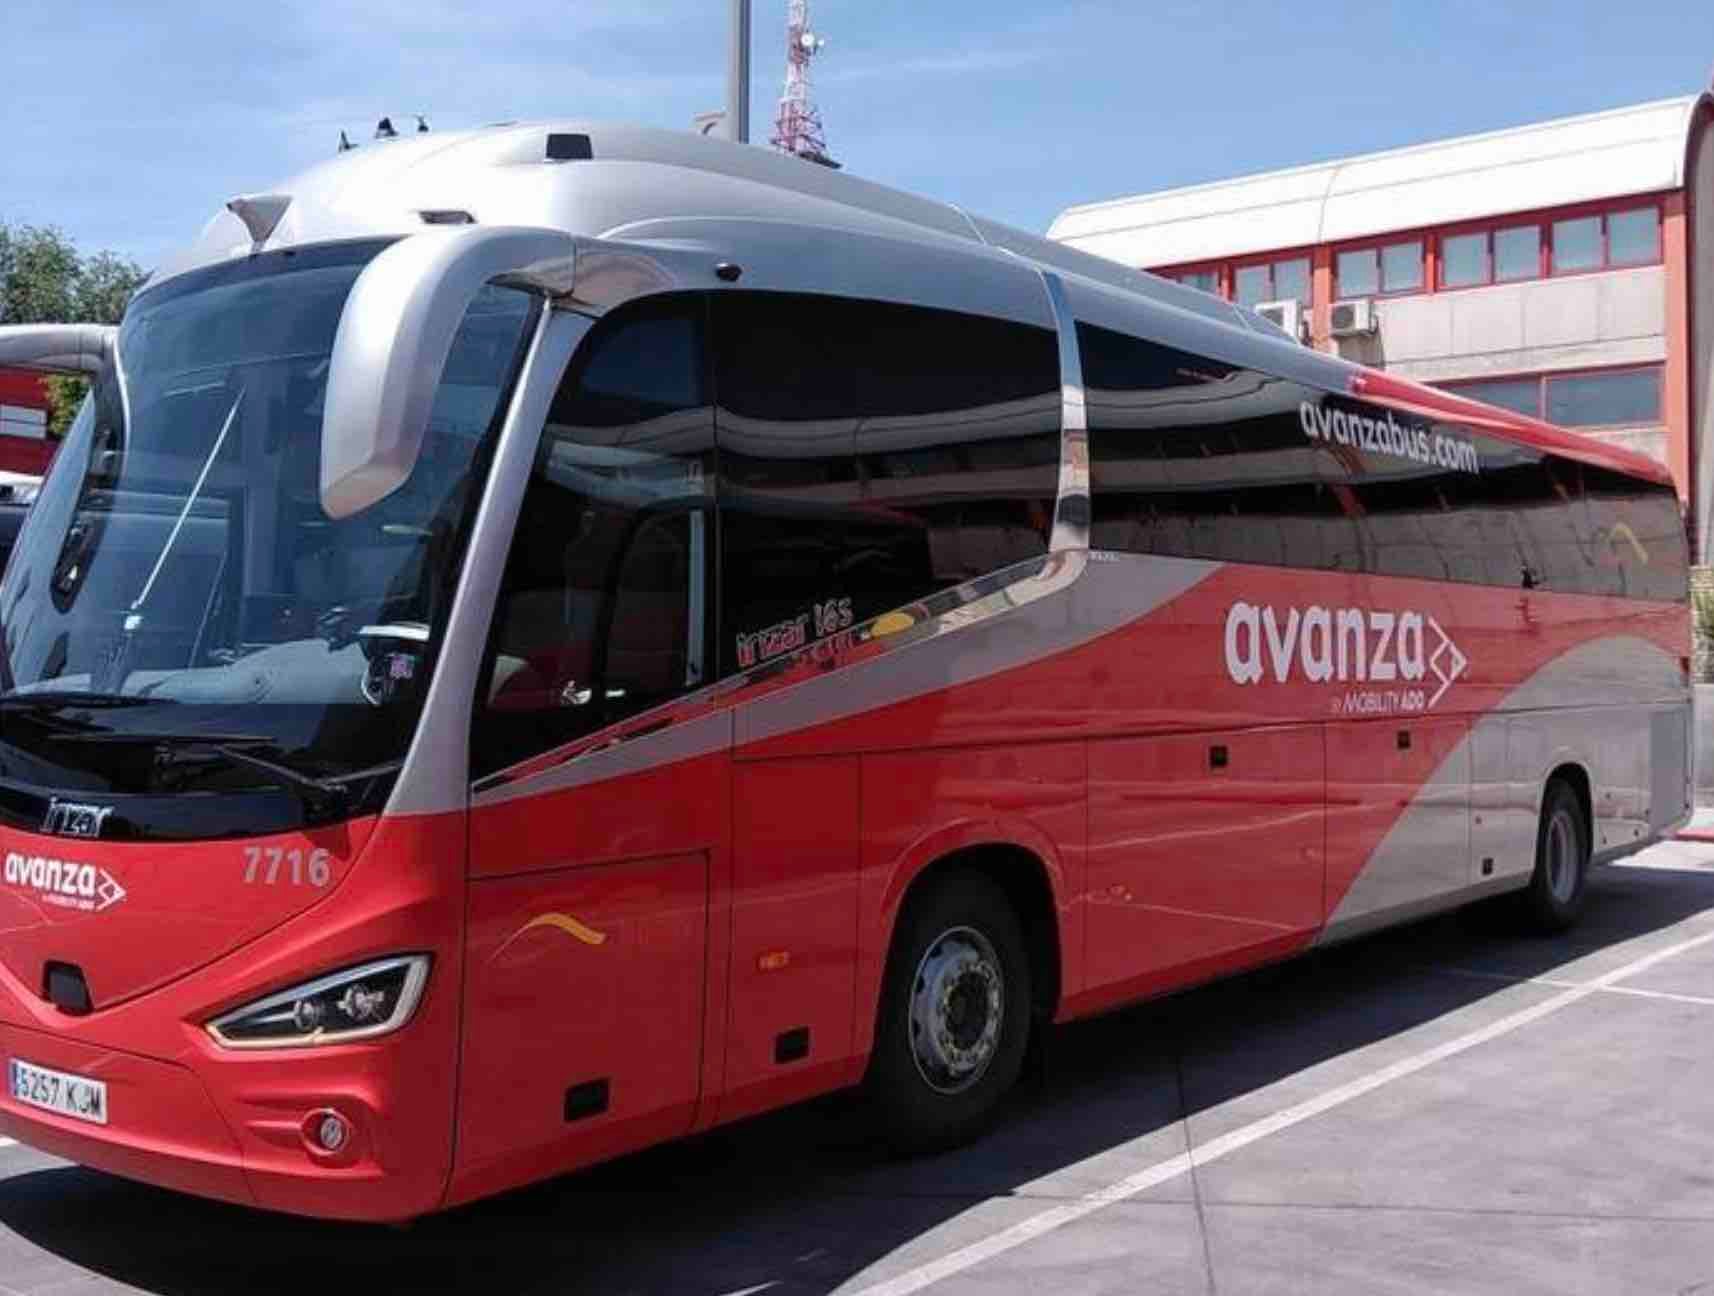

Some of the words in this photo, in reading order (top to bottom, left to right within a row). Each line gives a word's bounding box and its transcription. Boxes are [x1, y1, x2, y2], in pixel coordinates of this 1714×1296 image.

[1300, 400, 1479, 474] avanzabus.com
[1225, 602, 1426, 684] avanza
[5, 852, 96, 897] avanza
[243, 847, 330, 887] 7716
